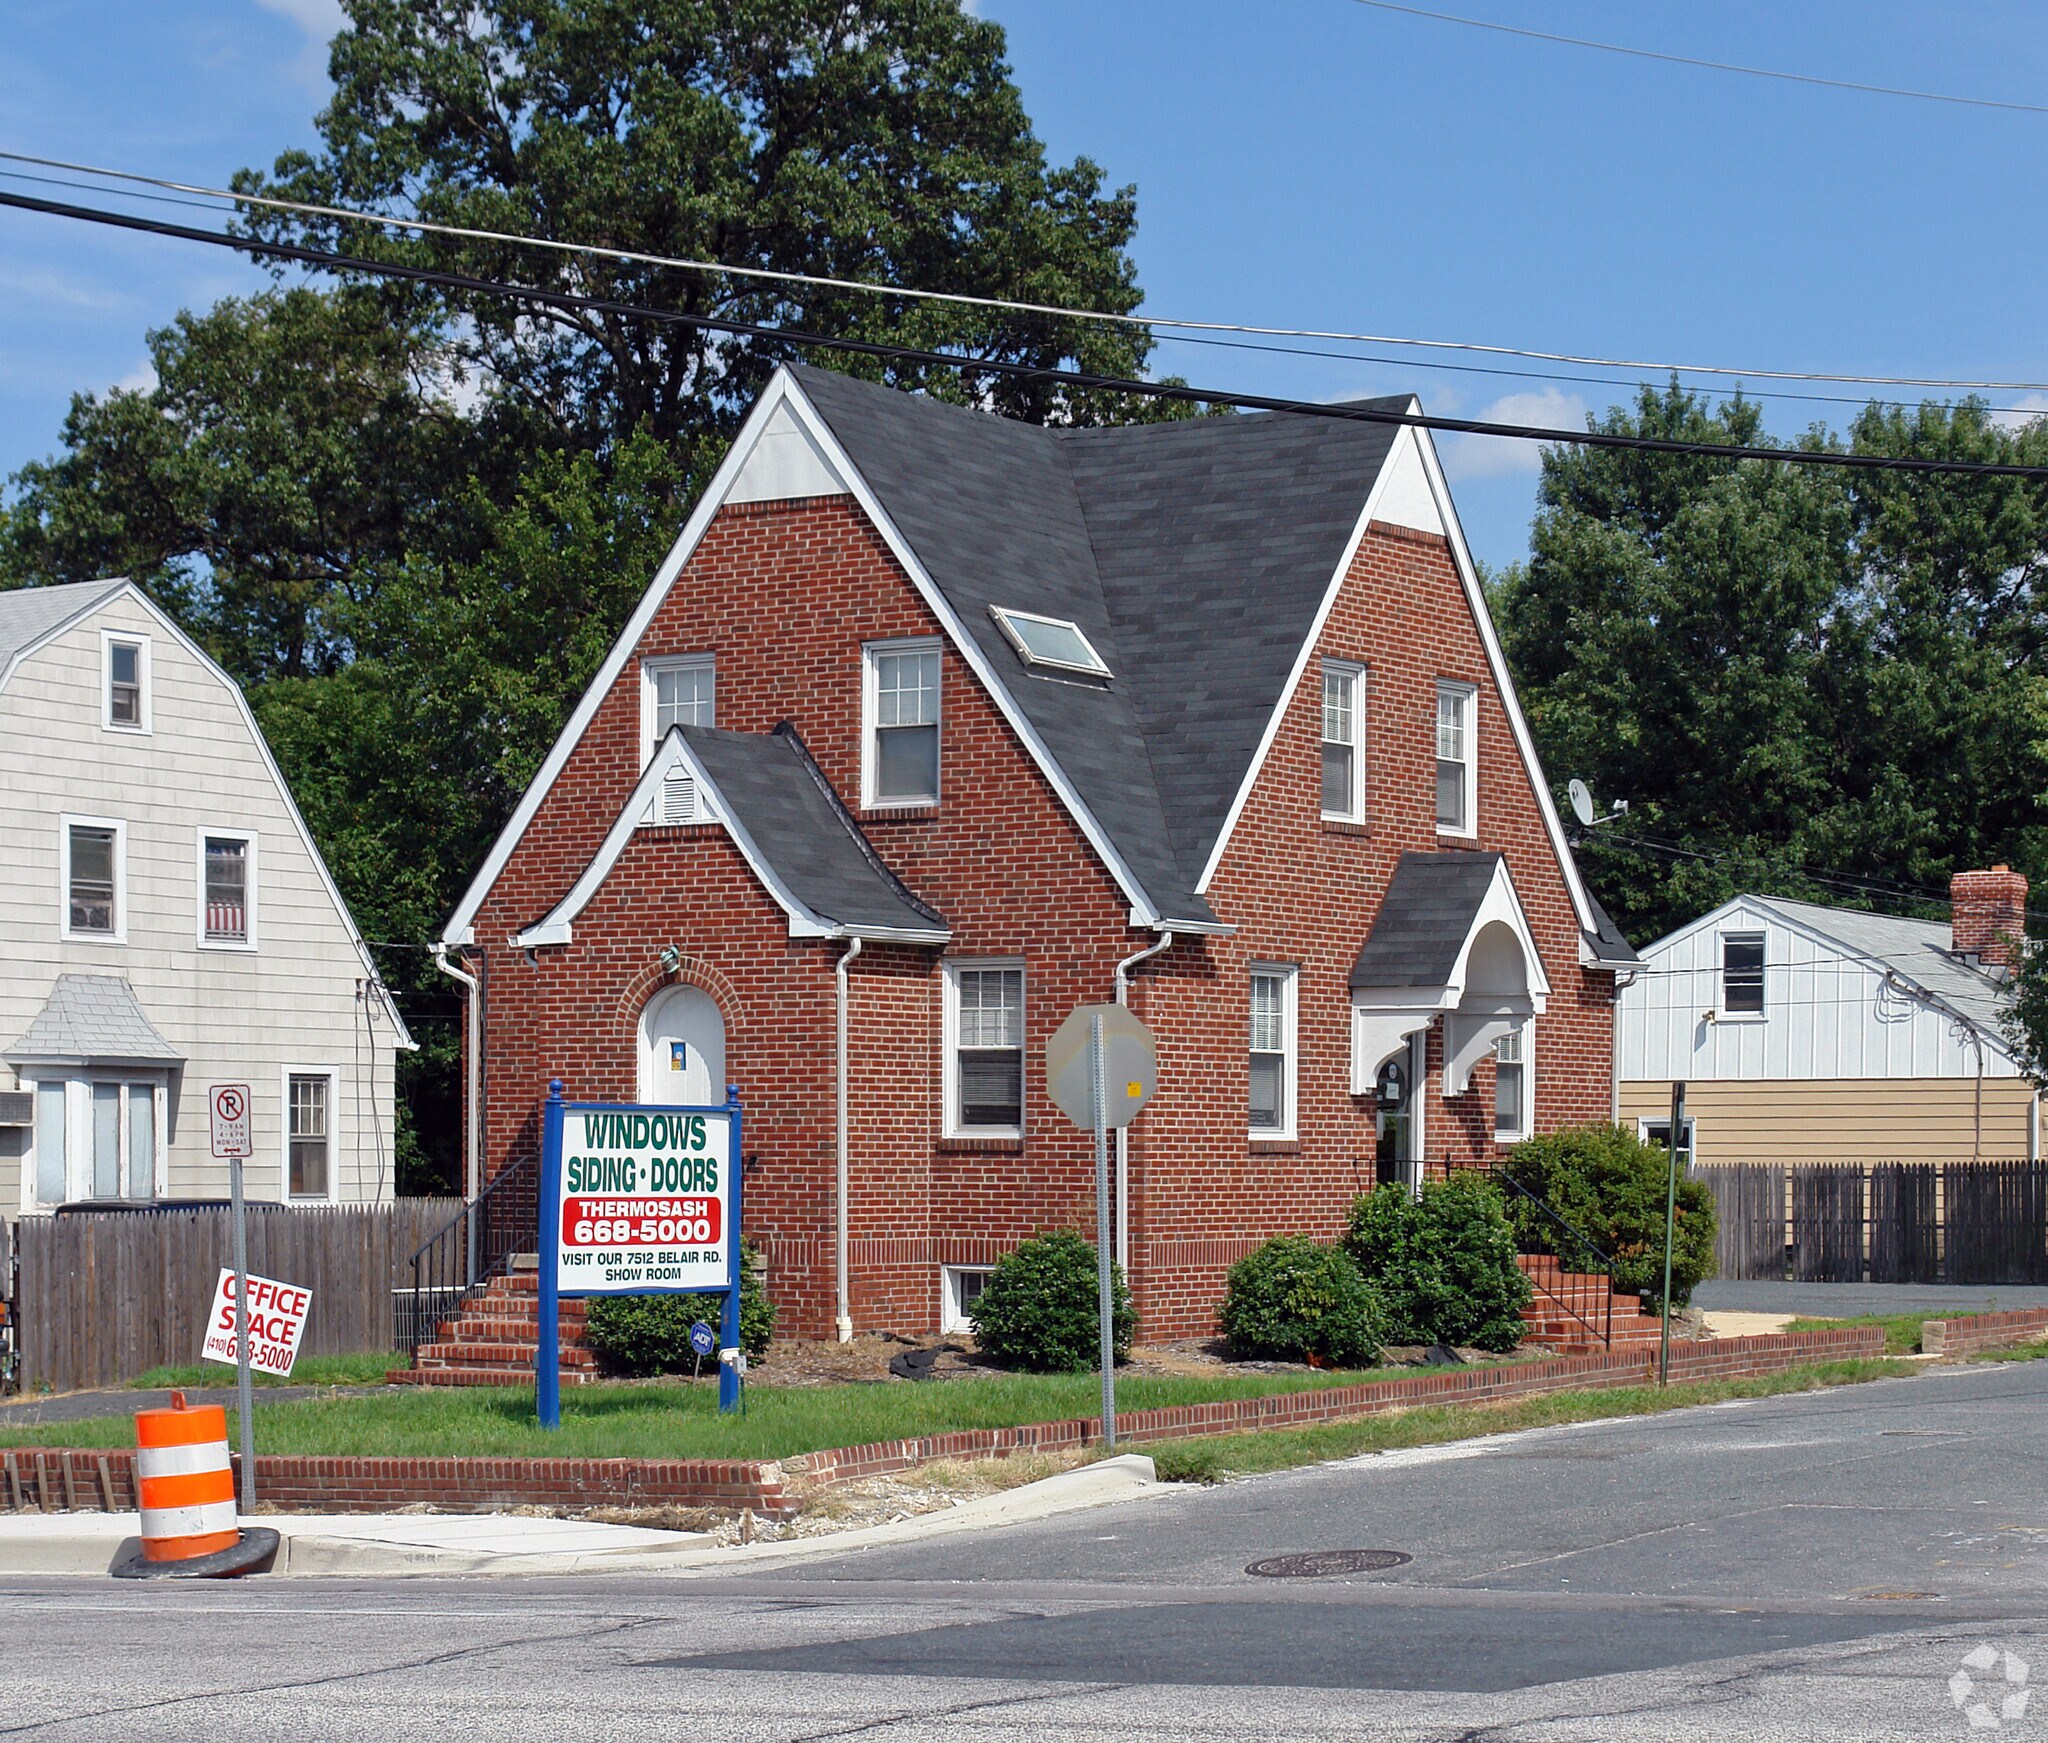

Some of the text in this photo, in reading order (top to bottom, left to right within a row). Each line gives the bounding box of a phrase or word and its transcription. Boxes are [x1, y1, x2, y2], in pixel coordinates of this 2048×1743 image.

[584, 1114, 706, 1150] WINDOWS
[567, 1156, 718, 1192] SIDING DOORS
[579, 1201, 708, 1217] THERMOSASH
[574, 1219, 711, 1243] 668-5000
[562, 1251, 722, 1265] VISIT OUR 7512 BELAIR RD.
[605, 1268, 681, 1281] SHOW ROOM
[693, 1332, 711, 1346] ADT
